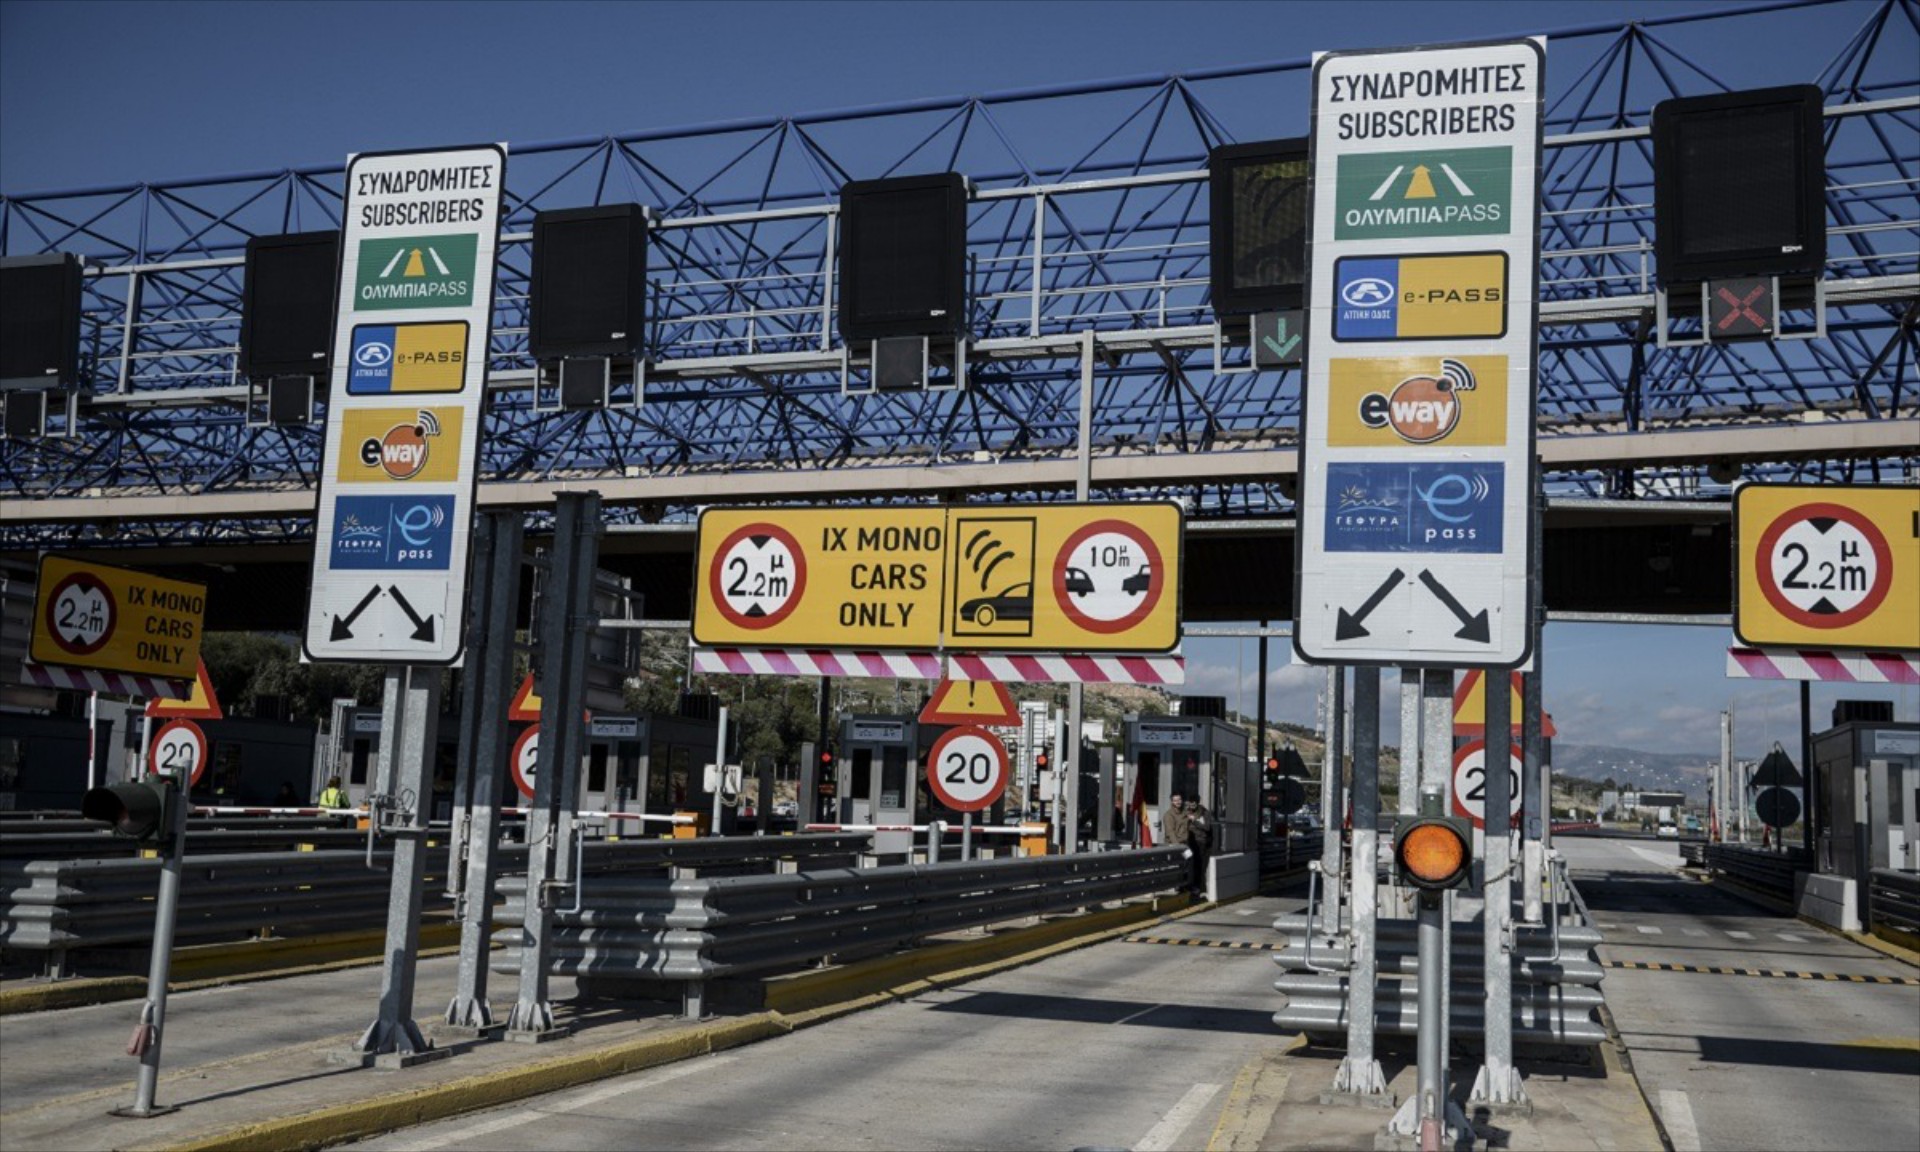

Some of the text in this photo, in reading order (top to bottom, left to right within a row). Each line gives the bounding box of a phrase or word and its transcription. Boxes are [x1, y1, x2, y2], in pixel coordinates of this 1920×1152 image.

[1330, 63, 1526, 102] ΣΥΝΔΡΟΜΗΤΕΣ
[1338, 104, 1516, 140] SUBSCRIBERS
[358, 165, 493, 196] ΣΥΝΔΡΟΜΗΤΕΣ
[361, 198, 483, 228] SUBSCRIBERS
[1404, 288, 1500, 303] e-PASS
[398, 351, 462, 363] e-PASS
[1361, 395, 1453, 429] eway
[362, 438, 424, 468] eway
[1336, 516, 1399, 525] ΓΕΦΥΡΑ
[338, 540, 382, 548] ΓΕΦΥΡΑ
[1425, 527, 1476, 542] pass
[398, 549, 433, 561] pass
[1091, 546, 1116, 567] 10
[851, 564, 927, 590] CARS
[839, 603, 915, 627] ONLY
[145, 616, 193, 639] CARS
[136, 641, 184, 664] ONLY
[945, 752, 991, 784] 20
